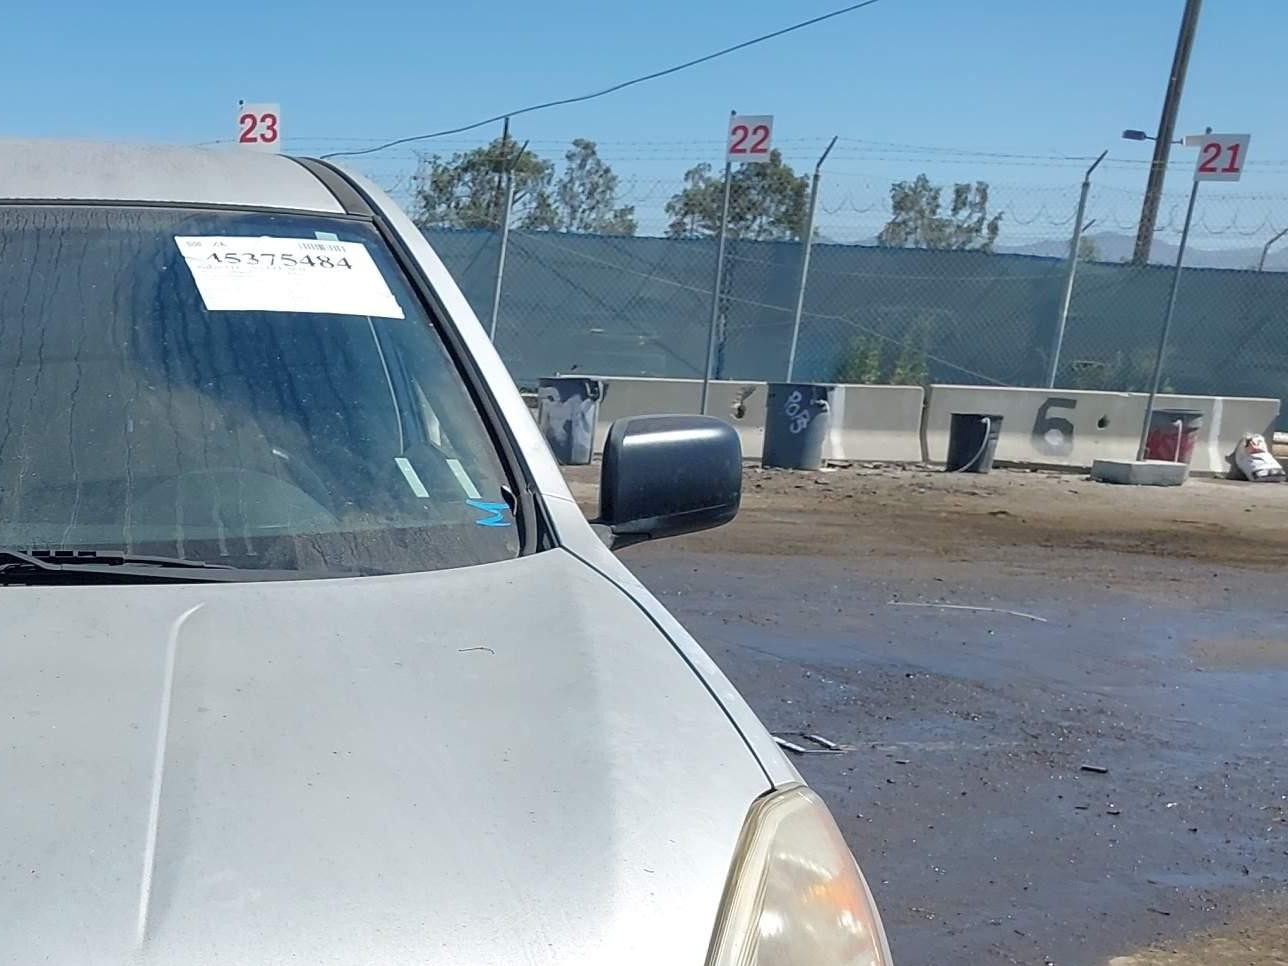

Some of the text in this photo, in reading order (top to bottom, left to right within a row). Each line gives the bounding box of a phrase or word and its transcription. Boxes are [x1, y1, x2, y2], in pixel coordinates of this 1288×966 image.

[239, 113, 278, 143] 23
[728, 124, 770, 154] 22
[1198, 142, 1241, 173] 21
[1030, 397, 1078, 457] 6
